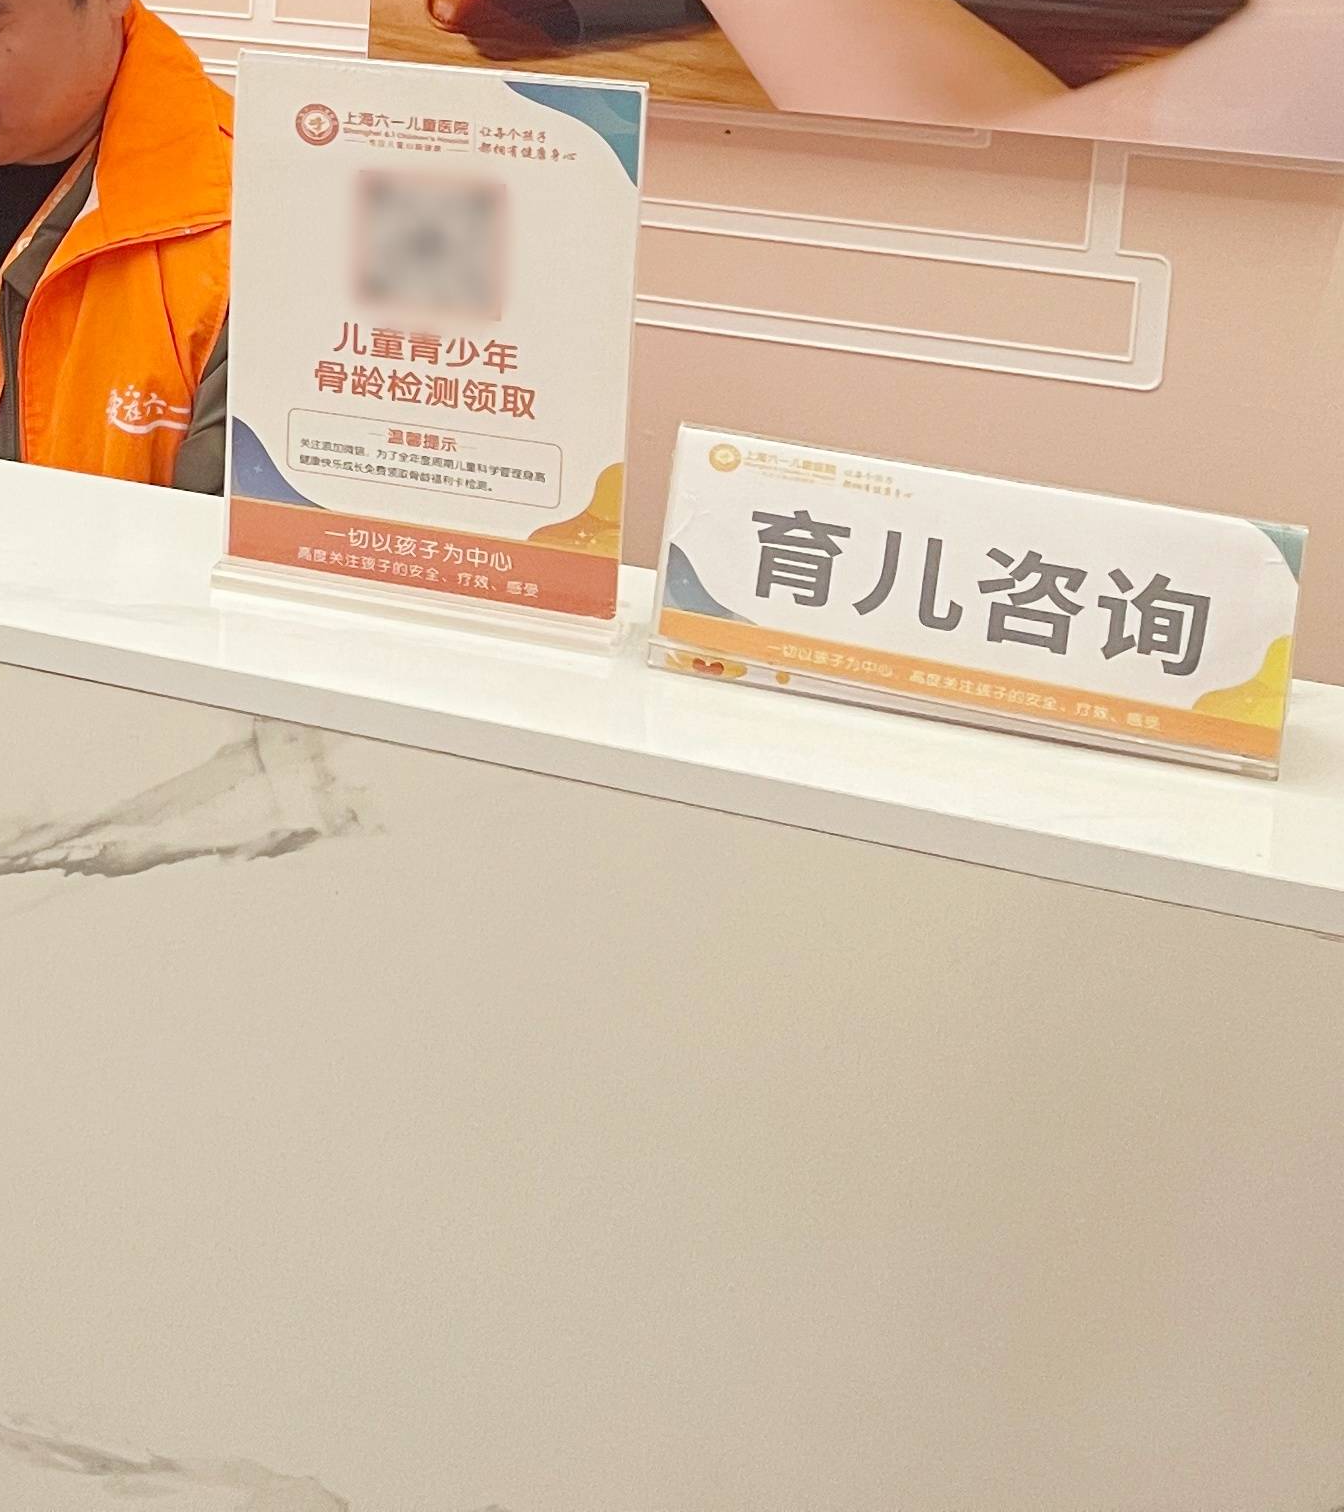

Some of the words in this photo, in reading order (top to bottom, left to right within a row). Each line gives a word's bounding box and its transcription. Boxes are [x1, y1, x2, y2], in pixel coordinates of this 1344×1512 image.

[343, 111, 470, 136] 上海六一儿童医院
[333, 322, 519, 374] 儿童青少年
[314, 361, 537, 420] 骨龄检测领取
[324, 527, 513, 572] 一切以孩子为中心
[752, 510, 1211, 676] 育儿咨询
